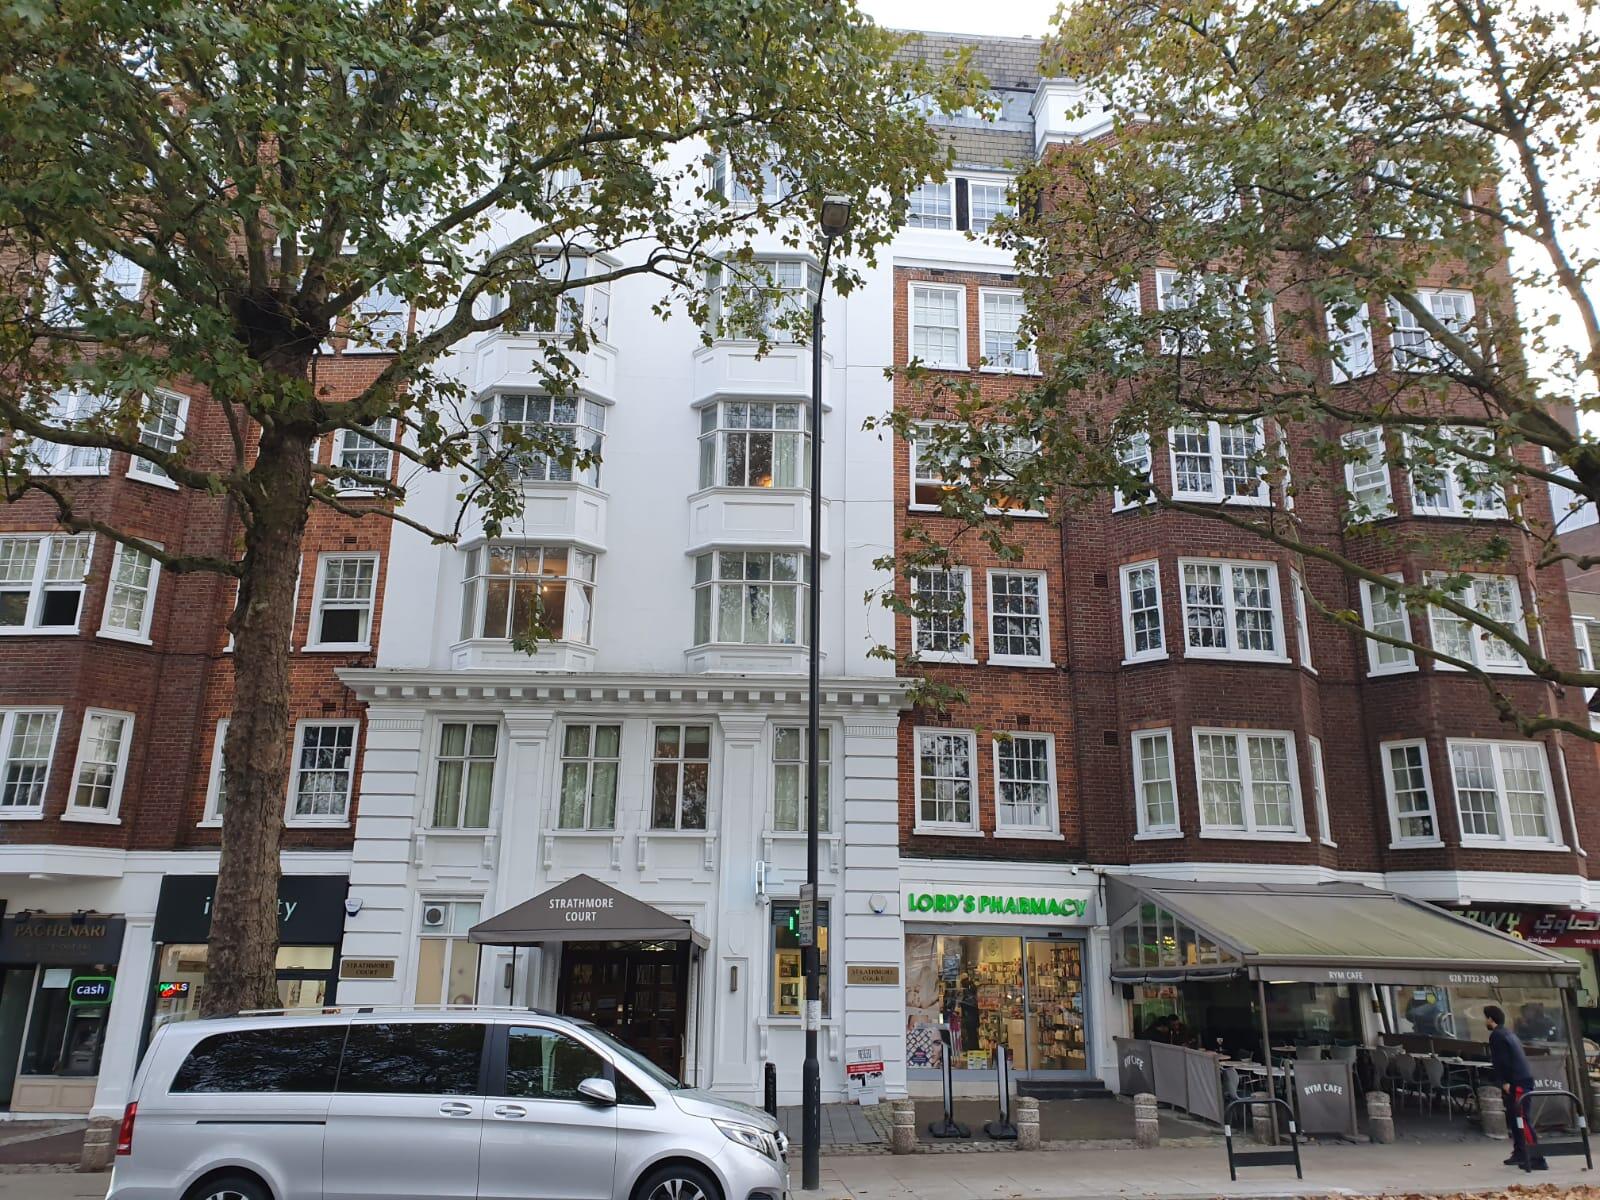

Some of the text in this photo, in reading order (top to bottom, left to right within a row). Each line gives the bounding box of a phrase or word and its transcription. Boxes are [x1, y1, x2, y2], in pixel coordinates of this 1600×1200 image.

[549, 898, 614, 909] STRATHMORE
[908, 893, 1088, 917] LORD'S PHARMACY
[565, 911, 597, 922] COURT
[1328, 971, 1363, 980] RYM CAFE
[76, 984, 104, 995] cash
[1304, 1083, 1343, 1096] RYM CAFE
